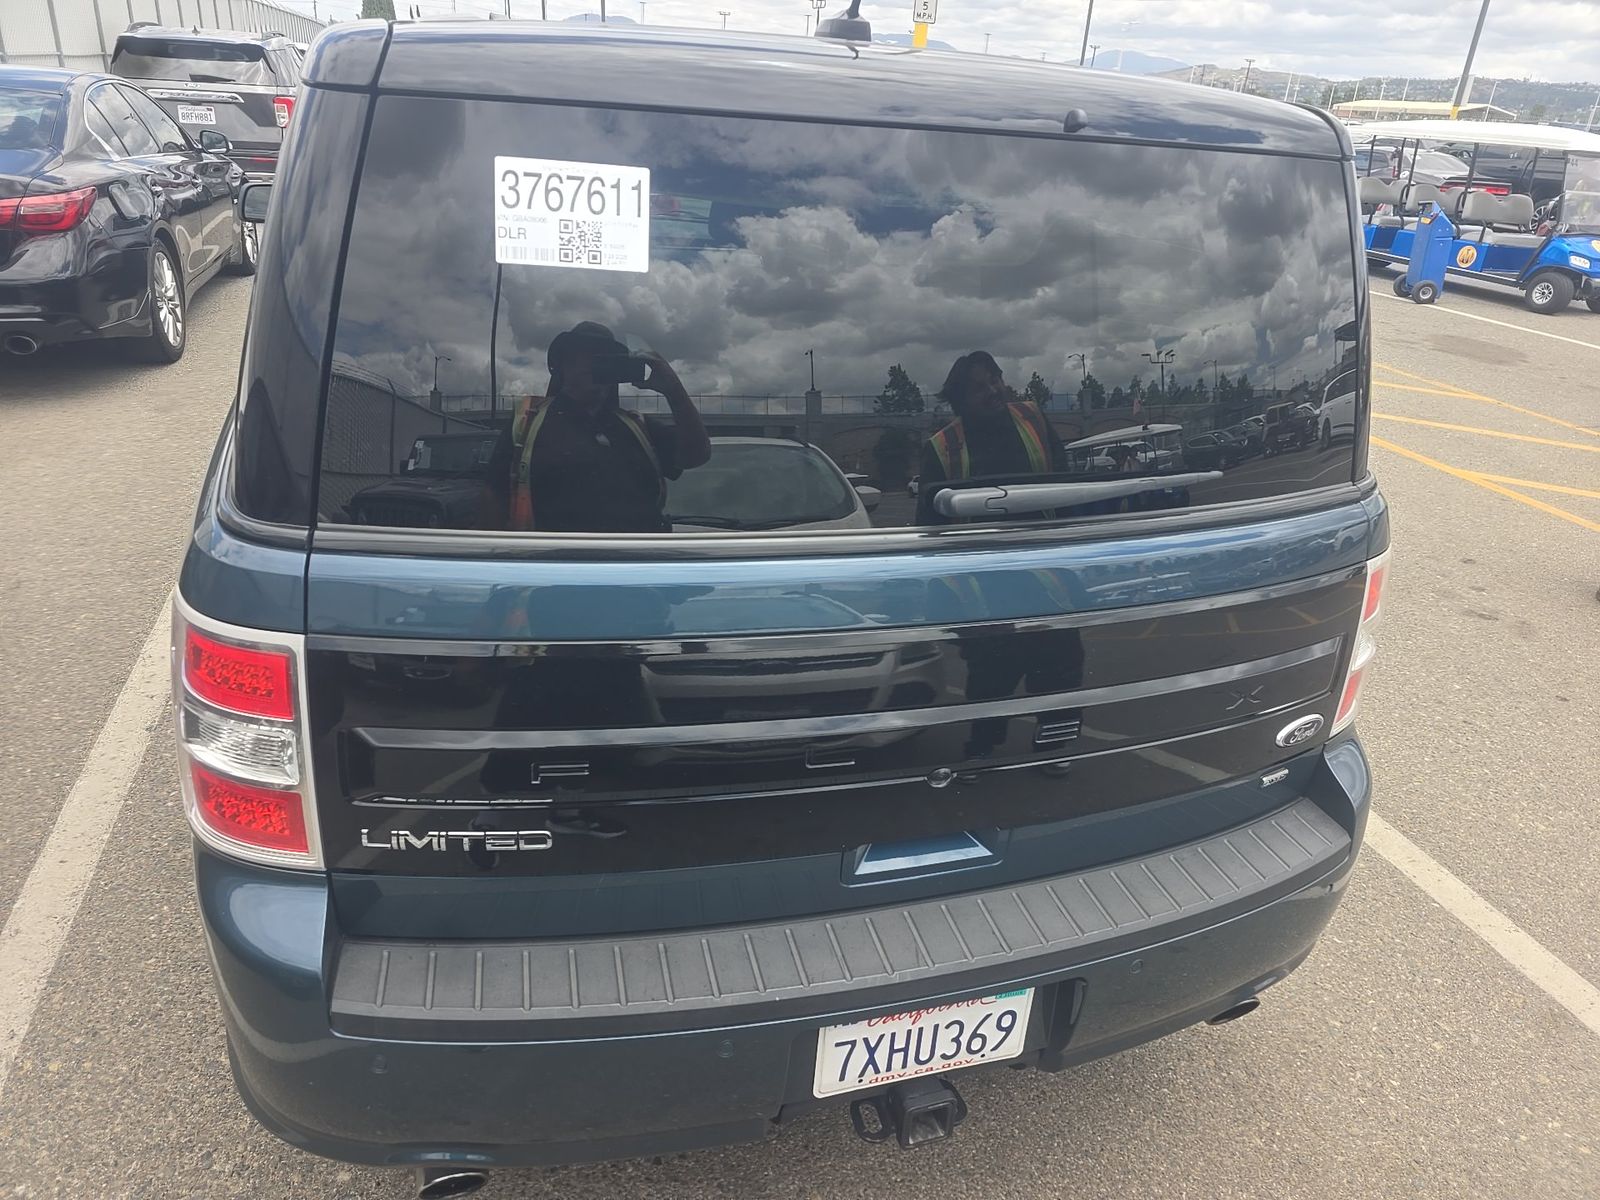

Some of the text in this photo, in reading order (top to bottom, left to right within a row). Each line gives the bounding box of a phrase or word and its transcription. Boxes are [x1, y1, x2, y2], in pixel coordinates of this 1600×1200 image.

[916, 12, 933, 20] MPH
[923, 1, 929, 11] 5
[501, 169, 642, 218] 3767611
[498, 226, 527, 240] DLR
[361, 828, 553, 851] LIMITED
[834, 1009, 1018, 1082] 7XHU369
[868, 1057, 975, 1084] dmv.ca.gov
